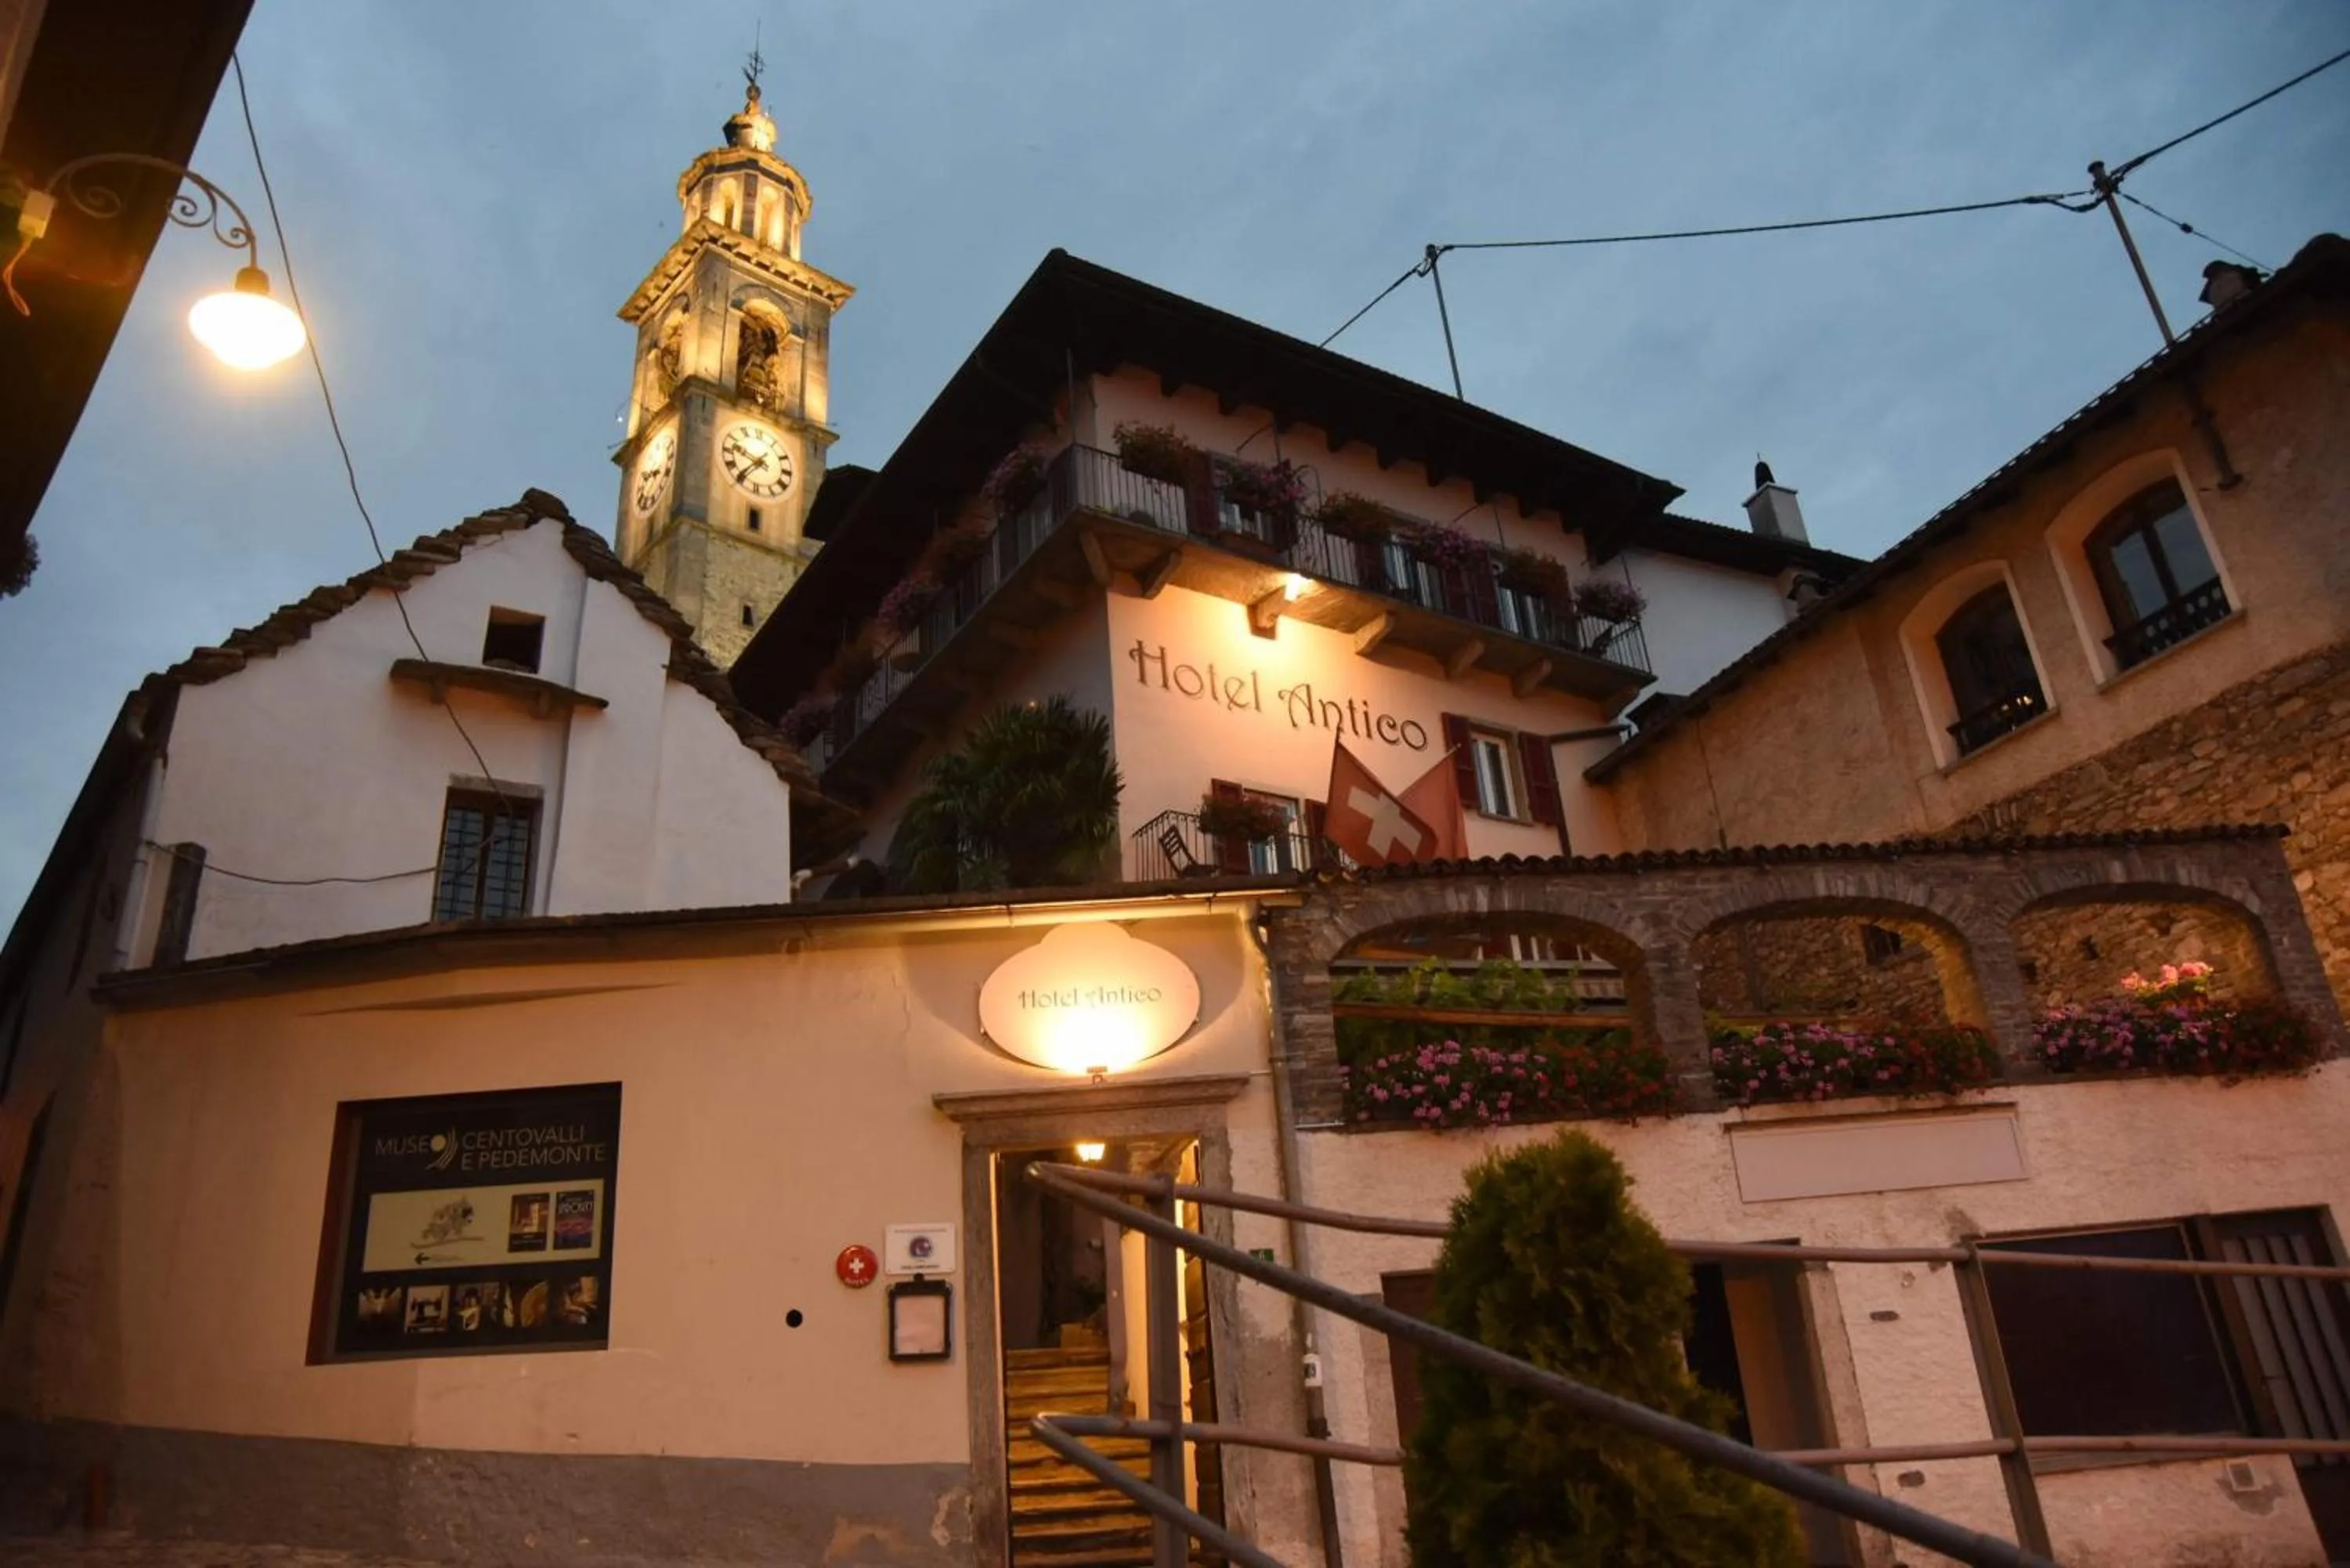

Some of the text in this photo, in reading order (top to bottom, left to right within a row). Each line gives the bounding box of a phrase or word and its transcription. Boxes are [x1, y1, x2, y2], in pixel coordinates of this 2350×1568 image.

[1128, 639, 1428, 752] Hotel Antico
[1018, 986, 1163, 1009] Hotel Antico
[462, 1125, 584, 1150] CENTOVALLI
[461, 1143, 606, 1171] E PEDEMONTE
